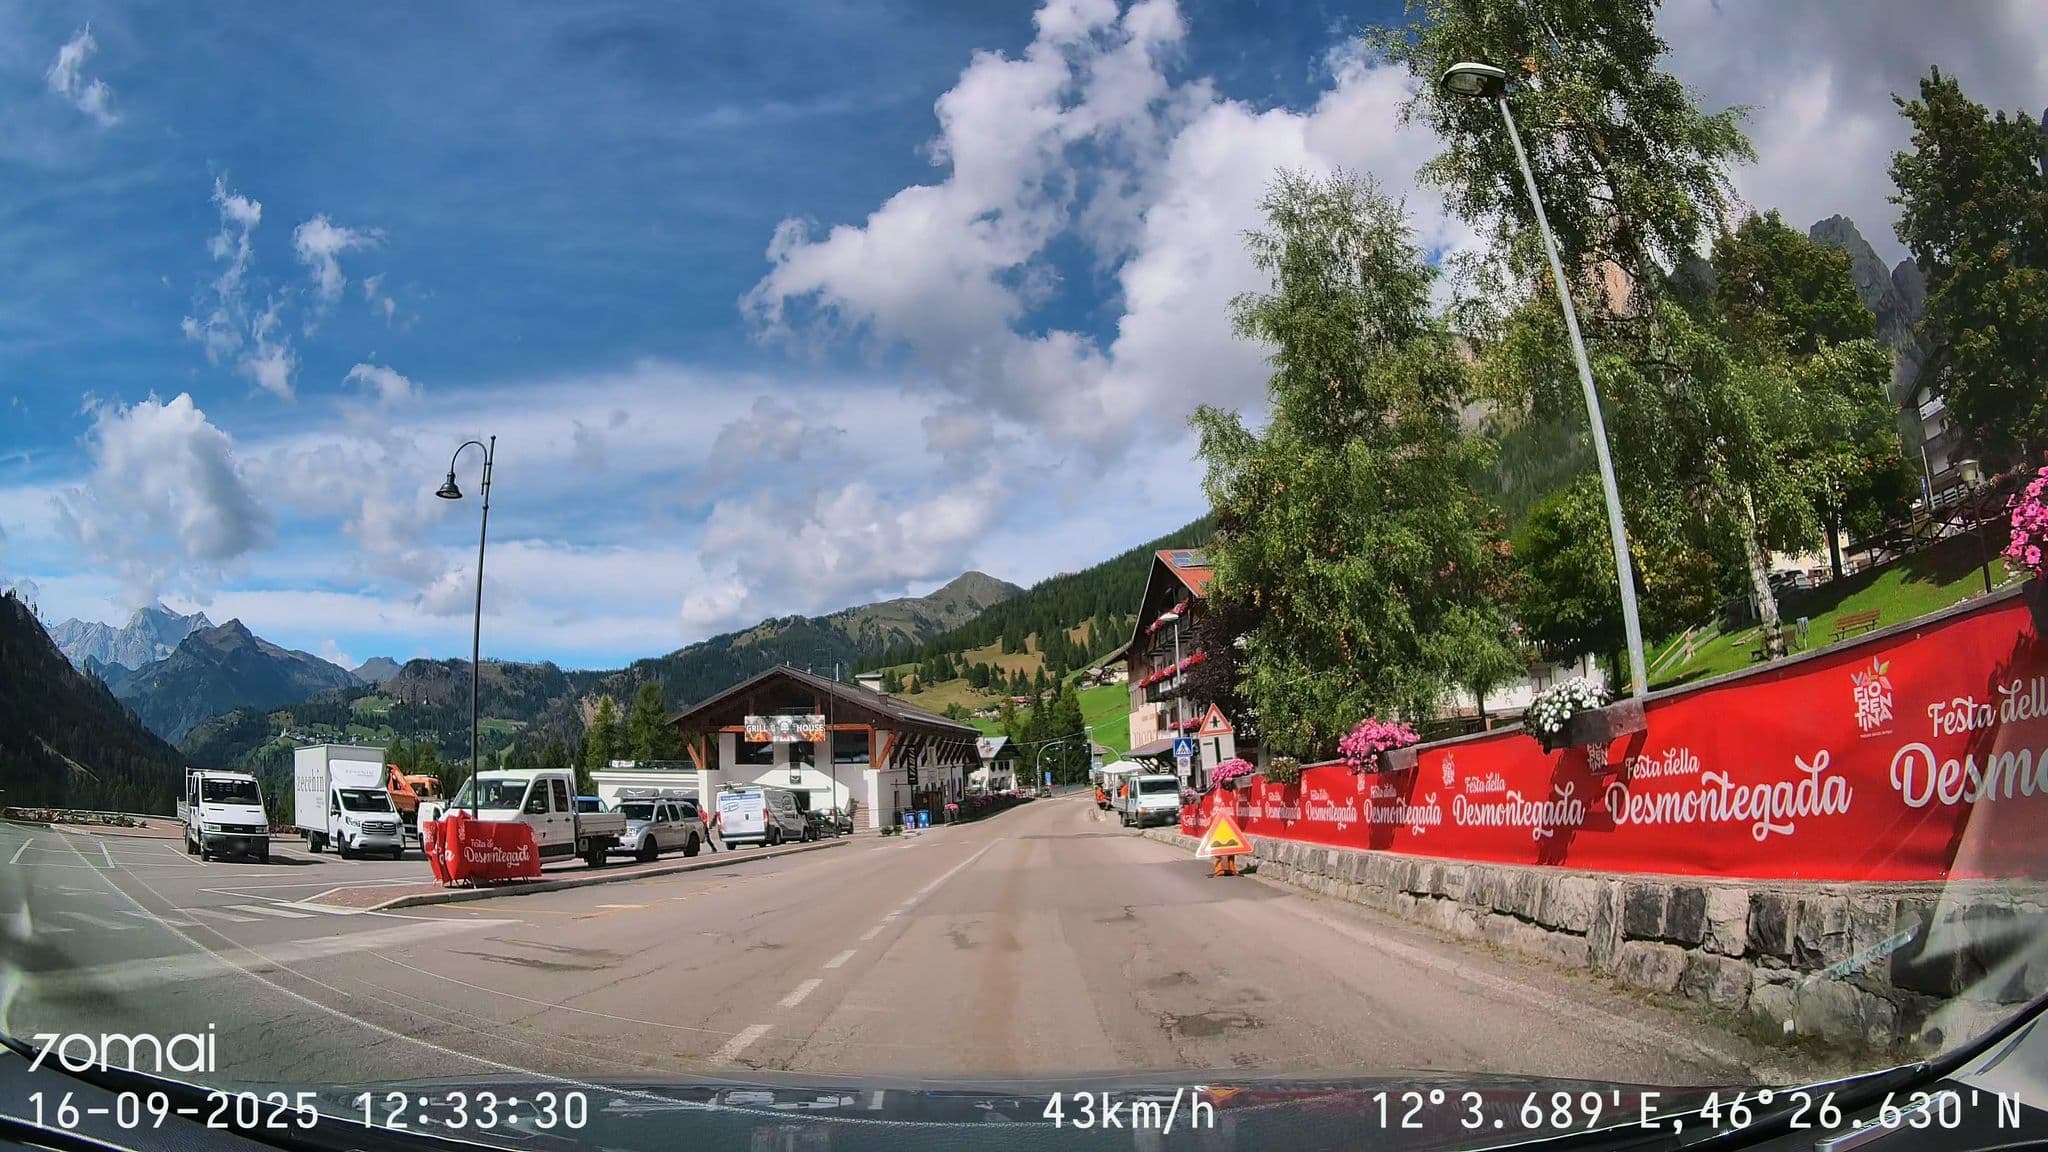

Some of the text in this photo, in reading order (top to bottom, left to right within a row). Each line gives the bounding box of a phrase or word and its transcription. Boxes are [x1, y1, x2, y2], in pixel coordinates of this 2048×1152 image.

[746, 724, 824, 732] GRILL HOUSE
[1927, 676, 2048, 738] Festa dell
[1464, 772, 1506, 794] Festa della
[1625, 747, 1700, 781] Festa della
[1363, 792, 1443, 836] Desmontegada
[1452, 781, 1586, 841] Desmontegada
[1604, 749, 1853, 842] Desmontegada
